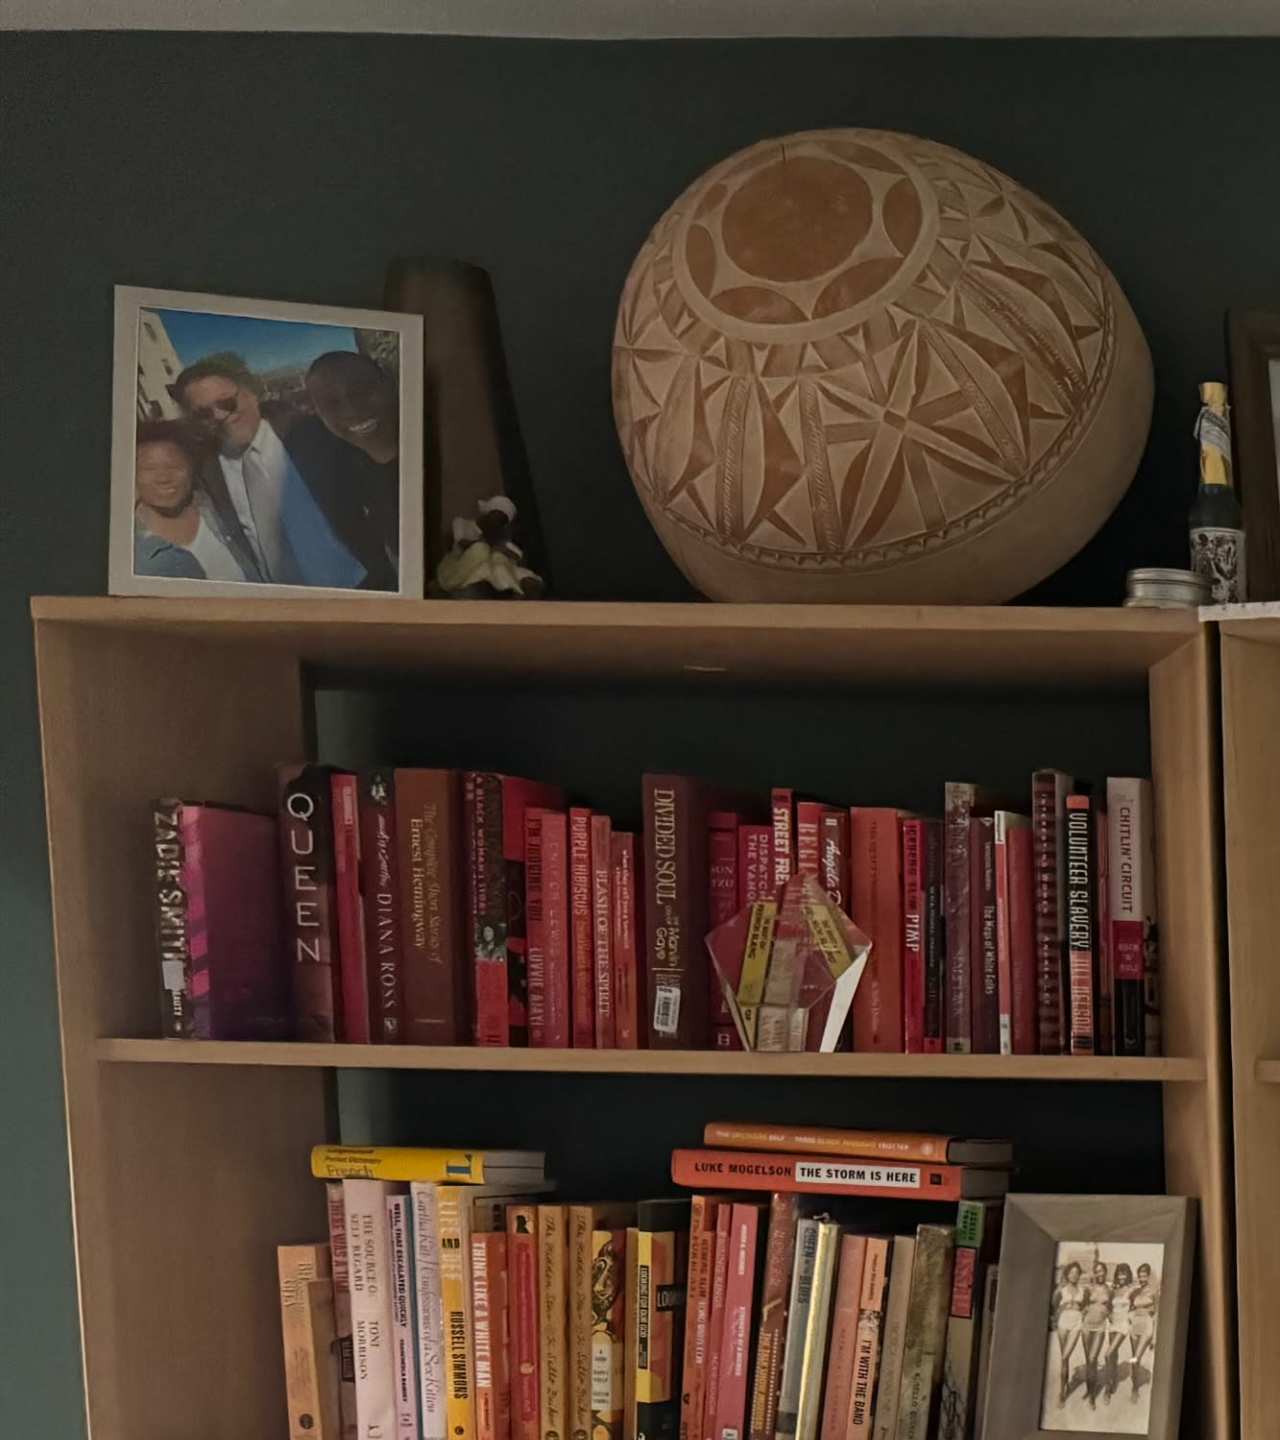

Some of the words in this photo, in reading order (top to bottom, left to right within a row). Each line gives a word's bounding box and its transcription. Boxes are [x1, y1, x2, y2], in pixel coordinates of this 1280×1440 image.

[571, 816, 588, 858] PURPLE
[653, 788, 676, 859] DIVIDED
[1119, 807, 1132, 861] CHITLIN'
[1068, 812, 1089, 885] VOLUNTEER
[287, 792, 321, 963] QUEEN
[574, 864, 590, 916] HIBISCUS
[656, 859, 677, 906] SOUL
[1120, 862, 1133, 913] CIRCUIT
[1069, 889, 1090, 949] SLAVERY
[694, 1162, 725, 1175] LUKE
[728, 1164, 792, 1178] MOGELSON
[799, 1167, 822, 1179] THE
[825, 1168, 866, 1181] STORM
[870, 1170, 882, 1182] IS
[886, 1171, 918, 1183] HERE
[472, 1241, 489, 1279] THINK
[473, 1282, 489, 1308] LIKE
[475, 1309, 489, 1318] A
[449, 1310, 465, 1351] RUSSELL
[475, 1320, 491, 1356] WHITE
[861, 1339, 872, 1354] I'M
[452, 1352, 469, 1399] SIMMONS
[476, 1359, 492, 1388] MAN
[858, 1356, 871, 1380] WITH
[856, 1382, 868, 1399] THE
[852, 1400, 867, 1425] BAND
